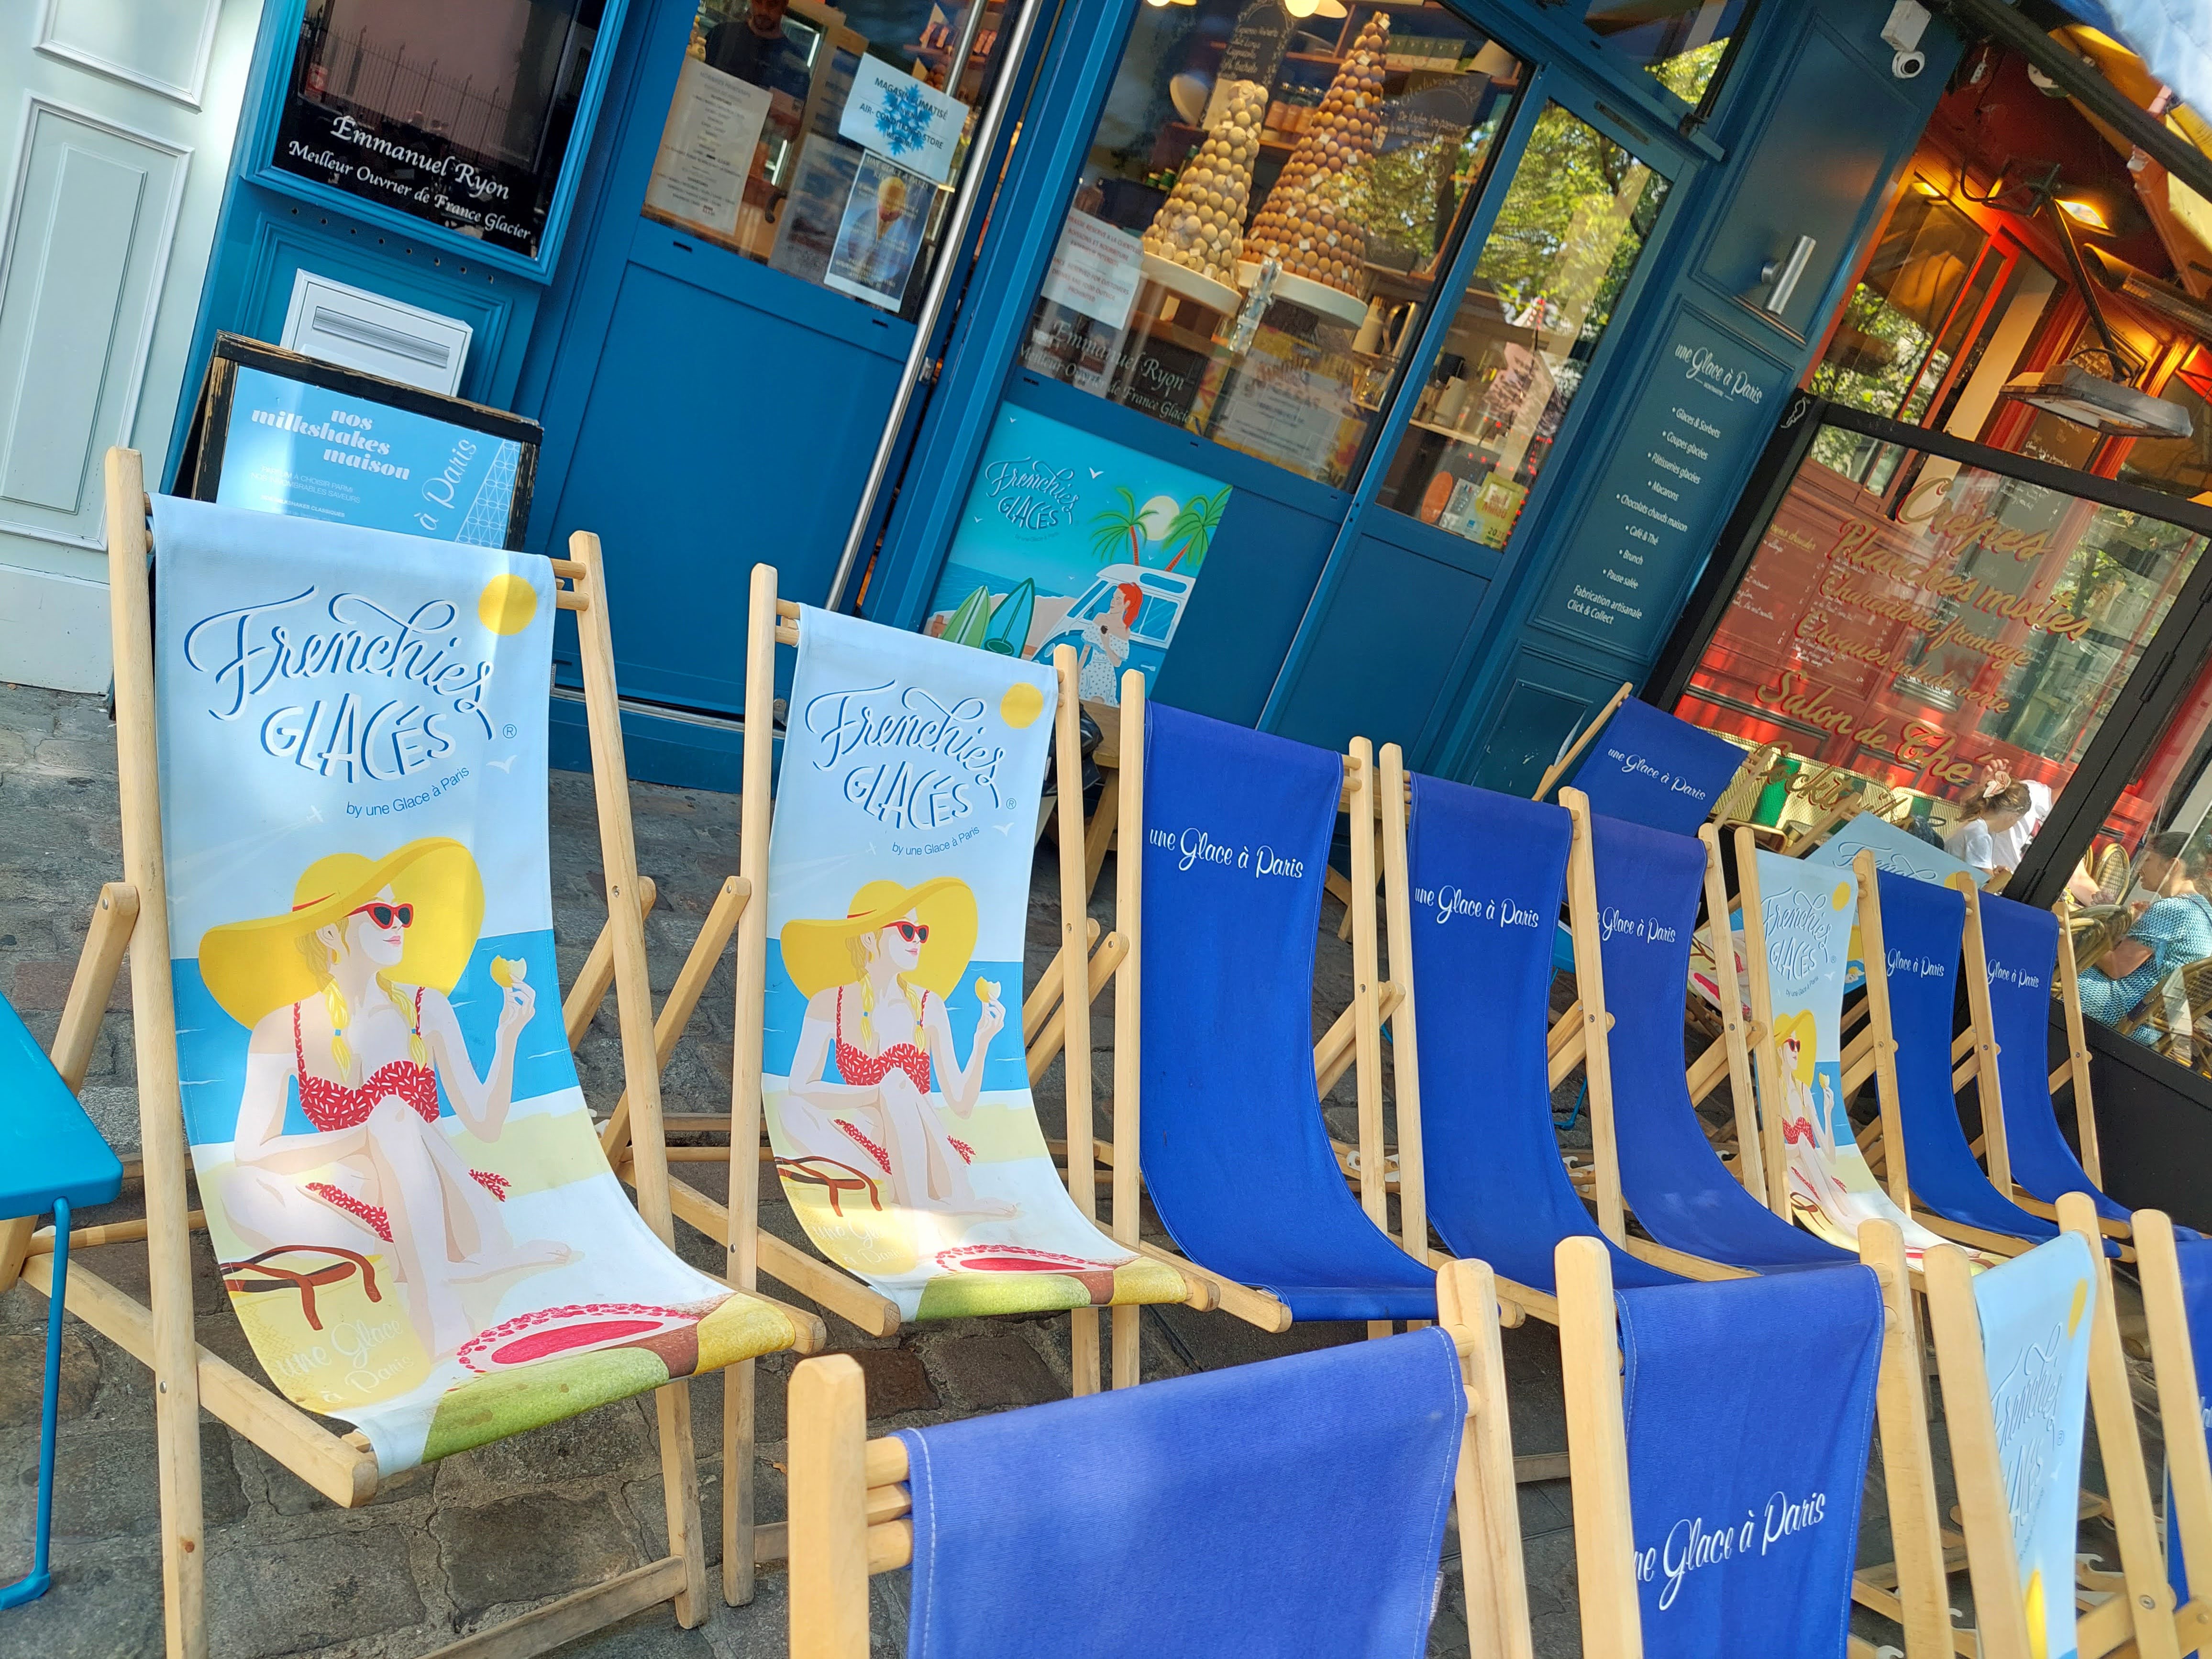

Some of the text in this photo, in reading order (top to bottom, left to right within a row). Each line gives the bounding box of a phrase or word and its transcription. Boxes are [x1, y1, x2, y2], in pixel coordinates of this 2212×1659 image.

[874, 77, 909, 101] MAGASIN
[330, 115, 509, 200] Emmanuel Ryon
[922, 134, 944, 150] STORE
[288, 140, 531, 240] Meilleur Ouvrier de France Glacier
[1142, 358, 1184, 392] Ryon
[1675, 343, 1762, 404] une Glace à Paris
[331, 409, 374, 431] nos
[1109, 379, 1119, 395] de
[1123, 385, 1159, 410] France
[1160, 401, 1196, 424] Glacier
[1676, 408, 1695, 425] Glaces
[1699, 420, 1721, 438] Sorbets
[251, 408, 391, 456] milkshakes
[1666, 431, 1709, 461] Coupes glacées
[300, 475, 330, 487] CHOISIR
[332, 482, 354, 493] PARMI
[323, 447, 410, 481] maison
[414, 439, 477, 531] à Paris
[1678, 465, 1701, 485] glacées
[328, 490, 361, 504] SAVEURS
[984, 455, 1079, 525] Frenchies
[1651, 479, 1680, 502] Macarons
[997, 494, 1059, 530] GLACÉS
[1620, 493, 1688, 533] Chocolats chauds maison
[1629, 525, 1659, 546] Café & Thé
[1606, 568, 1639, 590] Pause salée
[1623, 549, 1644, 566] Brunch
[1826, 518, 1980, 604] Planches
[1971, 580, 2093, 642] mixtes
[1567, 598, 1615, 625] Click & Collect
[1573, 584, 1643, 620] Fabrication artisanale
[184, 584, 496, 741] Frenchies
[1795, 608, 1891, 668] Croques
[1954, 682, 2010, 714] verte
[1924, 615, 2032, 671] fromage
[1756, 670, 1853, 737] Salon
[1852, 719, 1889, 749] de
[260, 692, 457, 785] GLACÉS
[805, 678, 1006, 809] Frenchies
[346, 766, 471, 818] by une Glace à Paris
[843, 760, 974, 830] GLACÉS
[1608, 748, 1707, 801] une Glace à Paris
[892, 825, 981, 857] by une Glace à Paris
[1150, 827, 1304, 879] une Glace à Paris
[1415, 885, 1539, 928] une Glace à Paris
[1602, 906, 1635, 942] Glace
[1637, 918, 1645, 938] à
[1647, 917, 1677, 944] Paris
[1760, 886, 1832, 964] Frenchies
[1770, 936, 1817, 981] GLACÉS
[1887, 948, 1912, 977] Glace
[1913, 956, 1919, 973] à
[1921, 955, 1944, 978] Paris
[1987, 958, 2040, 989] Glace à Paris
[1785, 988, 1791, 997] by
[275, 1319, 403, 1378] une Glace
[320, 1355, 415, 1404] à Paris
[1634, 1491, 1826, 1611] ne Glace à Paris
